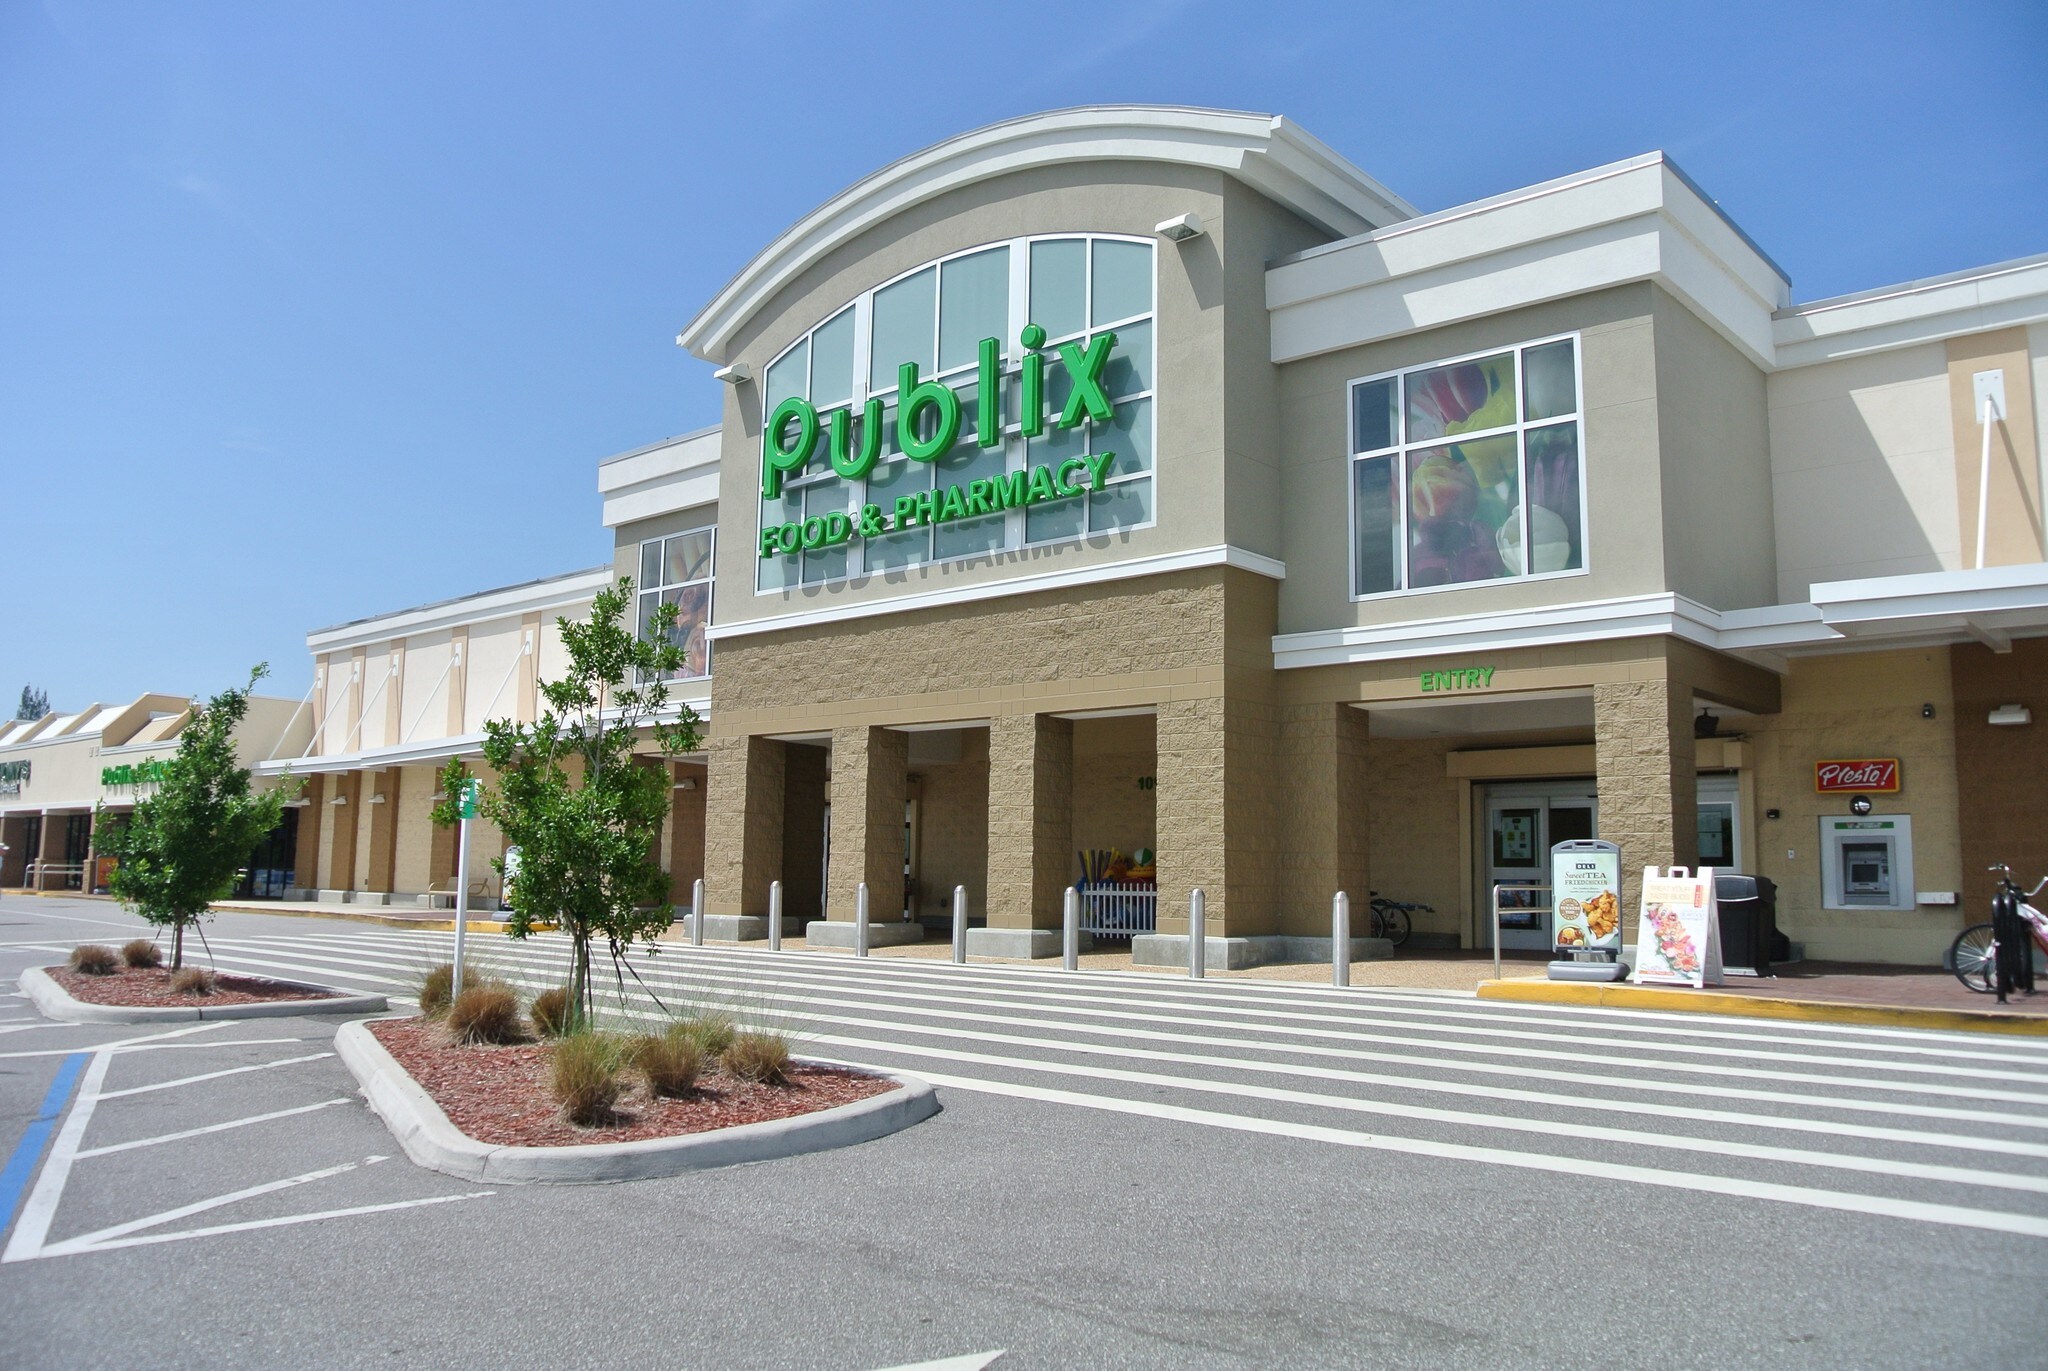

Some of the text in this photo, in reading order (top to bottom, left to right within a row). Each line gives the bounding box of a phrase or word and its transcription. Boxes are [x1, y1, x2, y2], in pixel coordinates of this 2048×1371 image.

[760, 452, 1116, 558] FOOD & PHARMACY
[1421, 666, 1495, 692] ENTRY
[1819, 764, 1894, 787] Presto!
